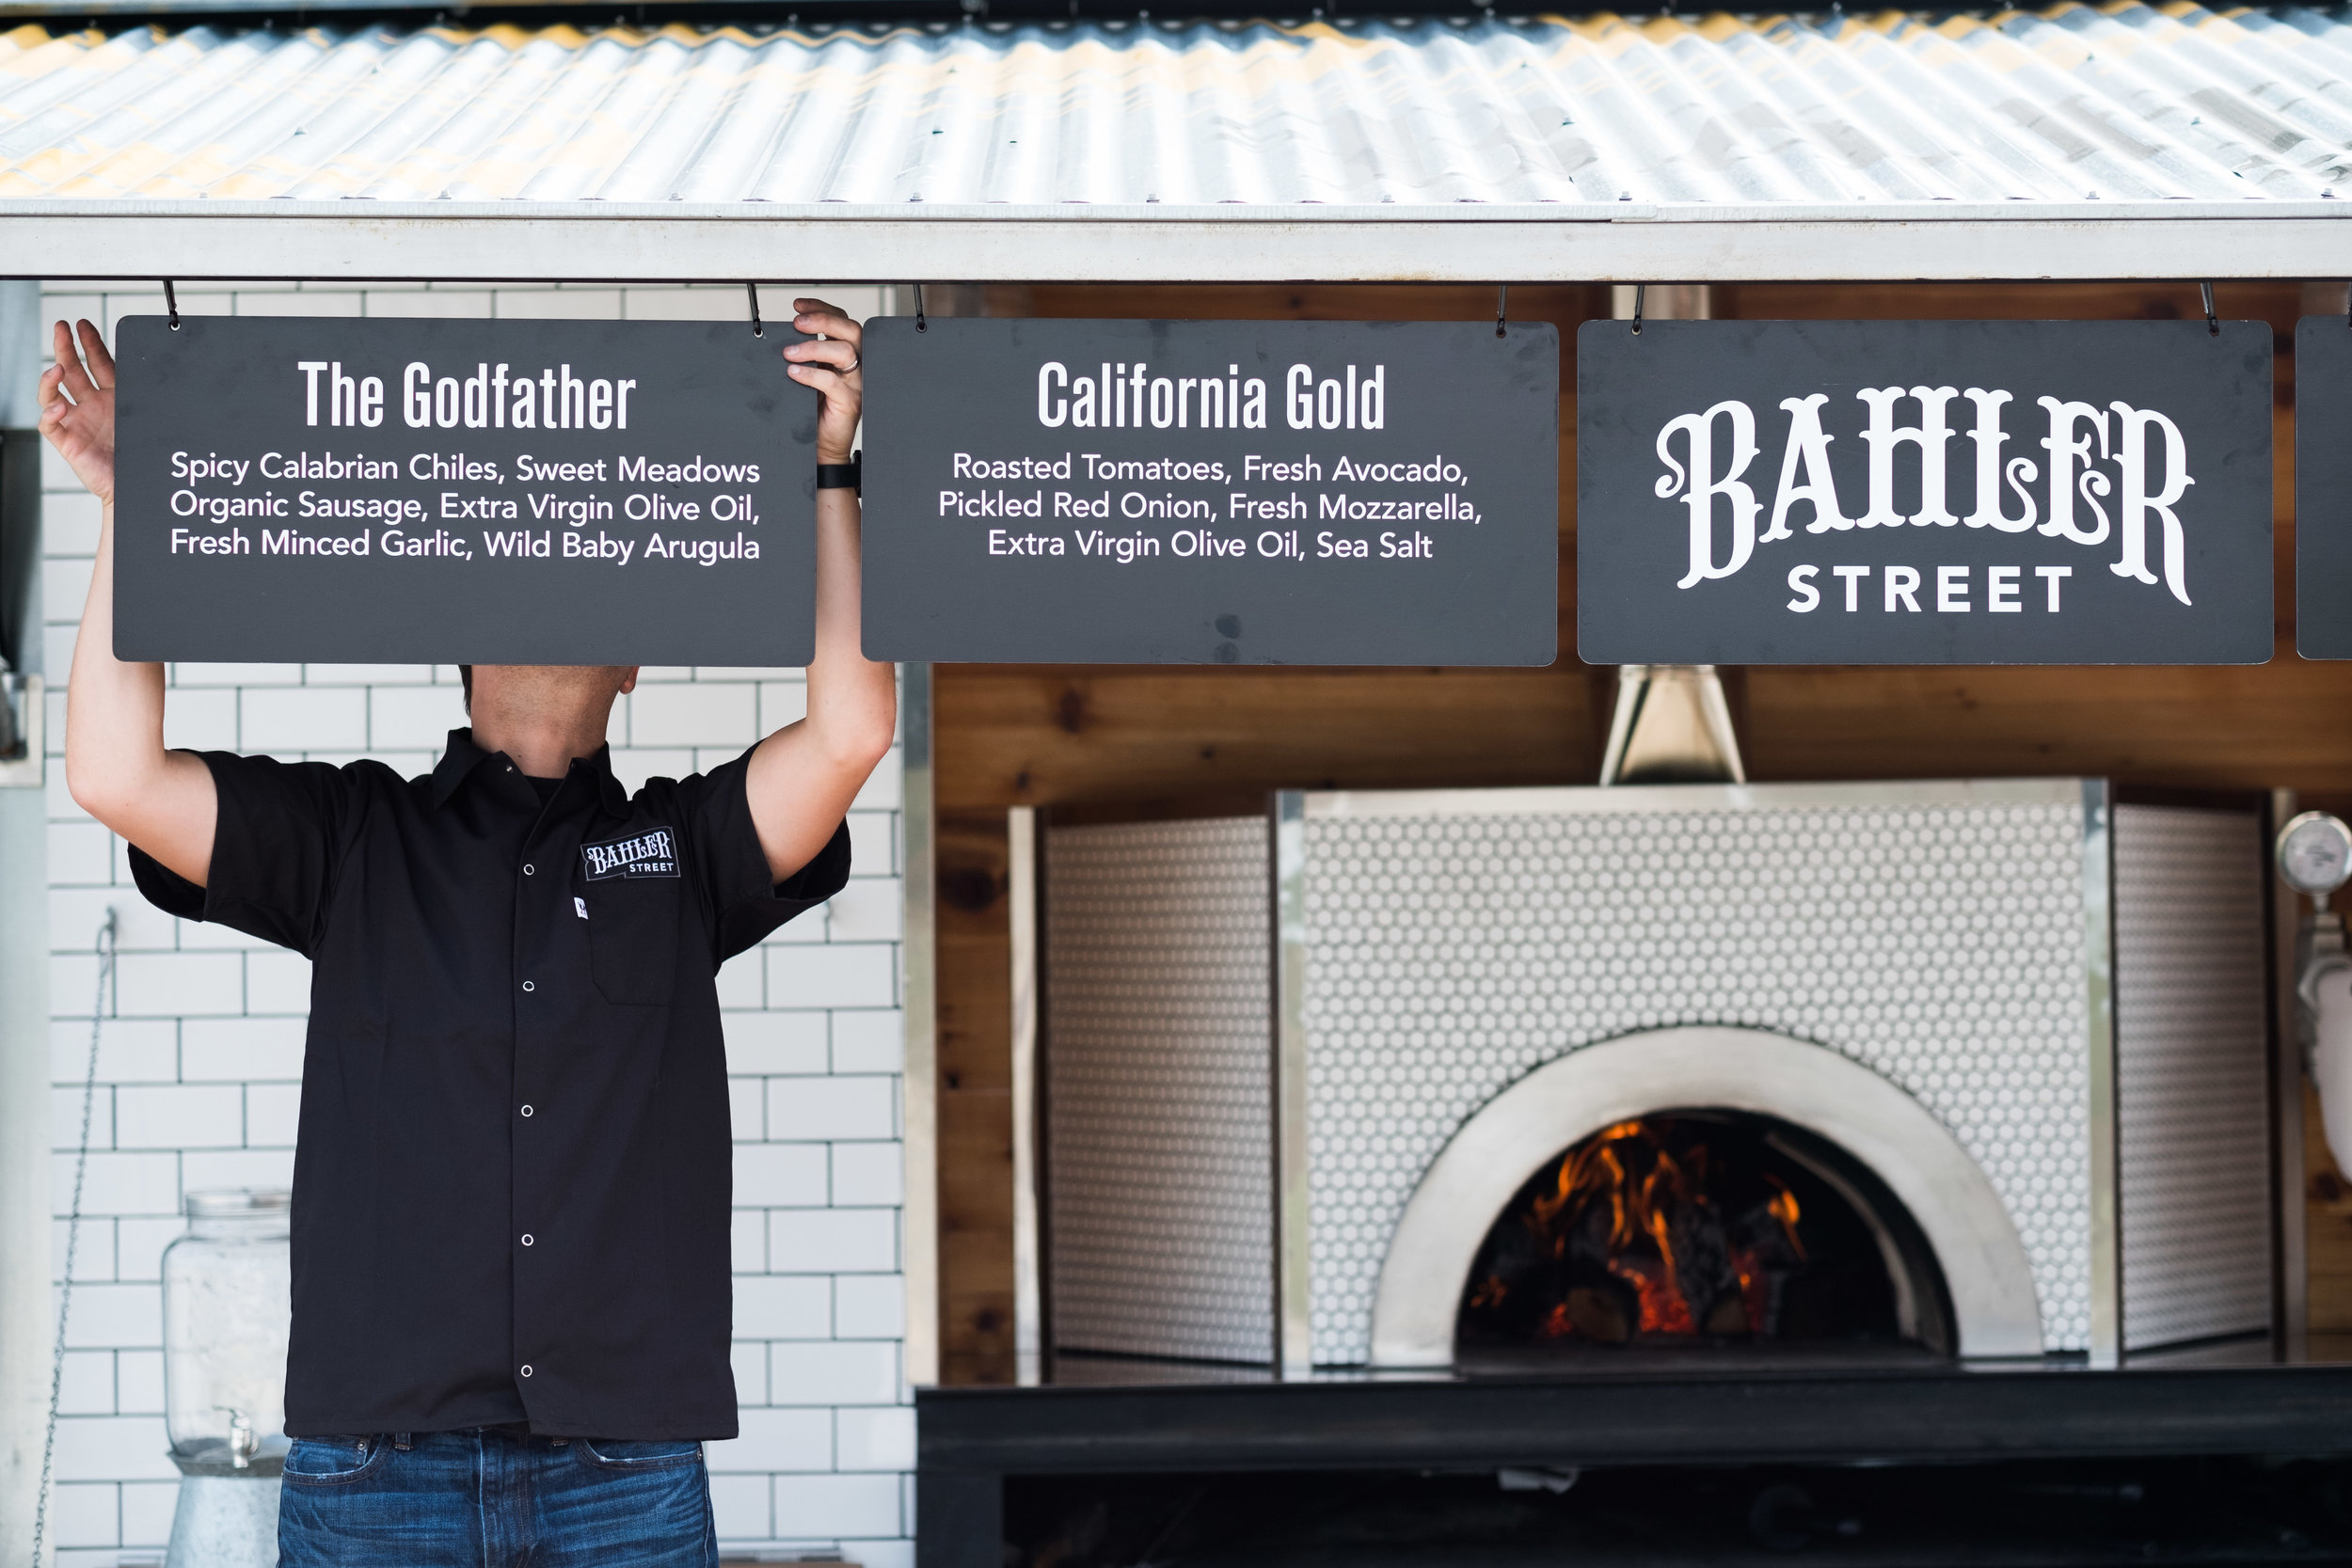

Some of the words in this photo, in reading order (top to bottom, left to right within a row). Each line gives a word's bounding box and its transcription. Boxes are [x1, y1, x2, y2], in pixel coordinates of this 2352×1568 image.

[298, 361, 384, 428] The
[404, 362, 637, 430] Godfather
[1039, 361, 1267, 429] California
[1287, 363, 1385, 431] Gold
[171, 451, 250, 487] Spicy
[260, 451, 398, 480] Calabrian
[409, 452, 505, 485] Chiles,
[516, 455, 608, 483] Sweet
[619, 455, 760, 483] Meadows
[954, 452, 1072, 480] Roasted
[1081, 454, 1232, 485] Tomatoes,
[1245, 454, 1322, 482] Fresh
[1332, 455, 1469, 487] Avocado,
[171, 490, 289, 525] Organic
[298, 491, 429, 526] Sausage,
[441, 493, 517, 519] Extra
[528, 493, 613, 528] Virgin
[625, 493, 701, 521] Olive
[711, 494, 760, 526] Oil,
[940, 490, 1042, 518] Pickled
[1055, 491, 1110, 518] Red
[1120, 492, 1217, 523] Onion,
[1231, 492, 1308, 520] Fresh
[1320, 493, 1482, 525] Mozzarella,
[1655, 386, 2195, 607] BAHLER
[172, 528, 250, 555] Fresh
[262, 529, 370, 556] Minced
[381, 530, 473, 562] Garlic,
[484, 531, 551, 558] Wild
[564, 531, 636, 566] Baby
[644, 532, 760, 567] Arugula
[990, 530, 1065, 556] Extra
[1074, 530, 1160, 564] Virgin
[1171, 530, 1247, 558] Olive
[1257, 531, 1306, 562] Oil,
[1317, 531, 1369, 559] Sea
[1380, 531, 1433, 559] Salt
[1787, 564, 2073, 613] STREET
[587, 831, 672, 875] BAHLER
[629, 863, 675, 873] STREET
